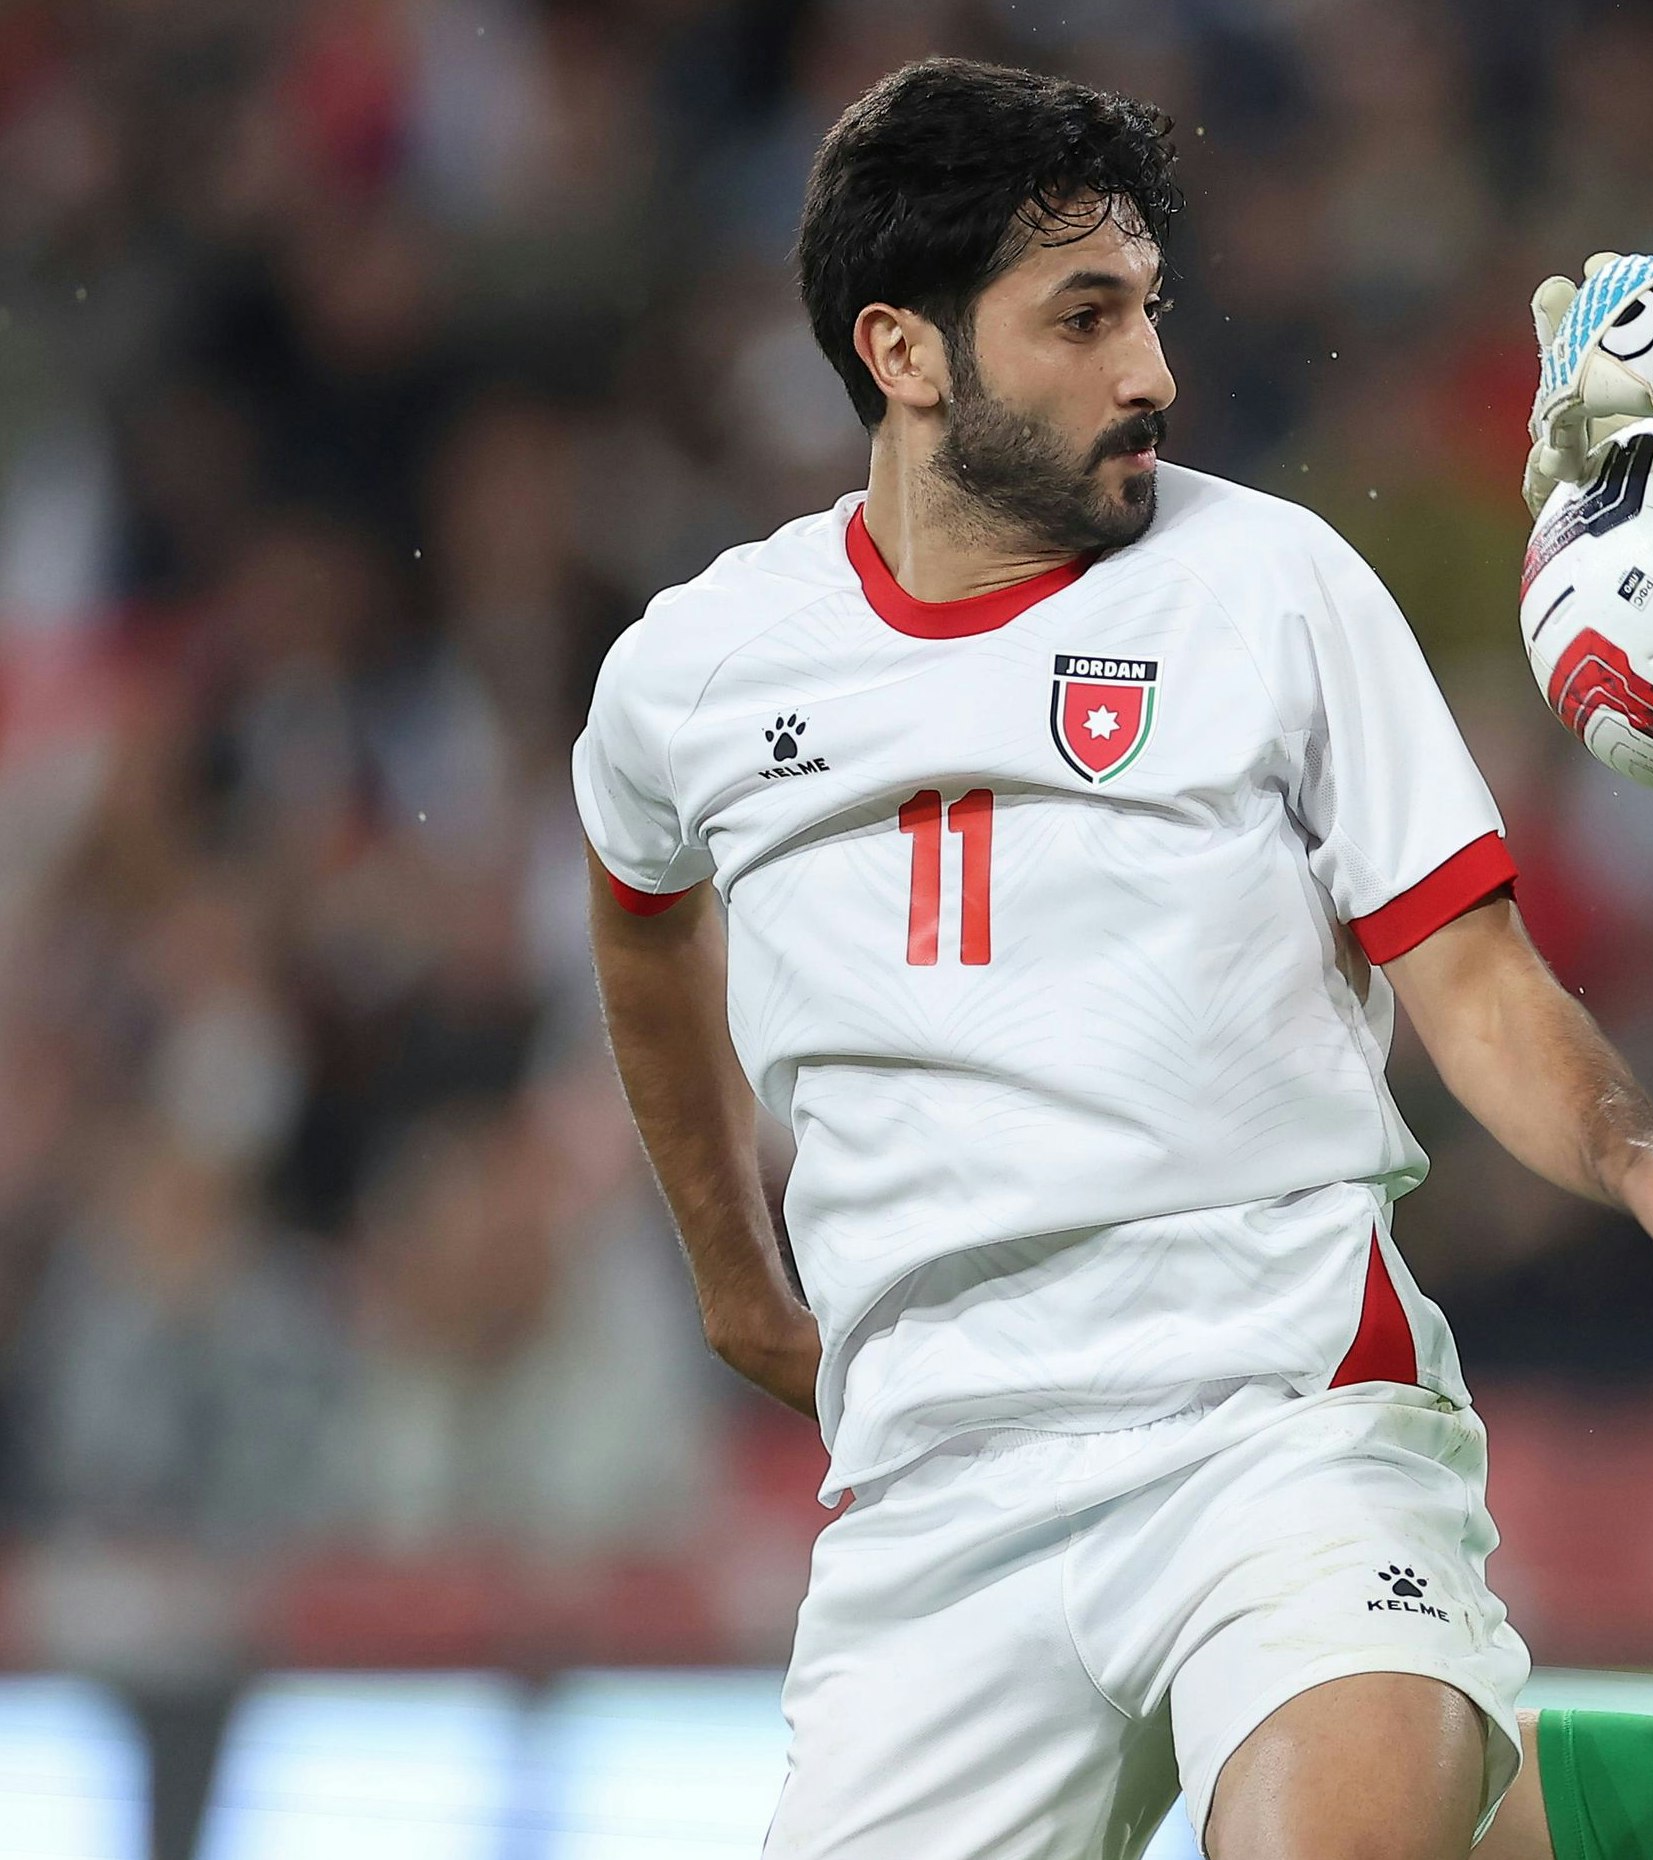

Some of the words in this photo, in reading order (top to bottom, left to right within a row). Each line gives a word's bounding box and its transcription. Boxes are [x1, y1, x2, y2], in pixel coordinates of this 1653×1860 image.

[1066, 658, 1146, 679] JORDAN
[758, 757, 831, 779] KELME
[899, 788, 994, 966] 11
[1366, 1598, 1450, 1623] KELME
